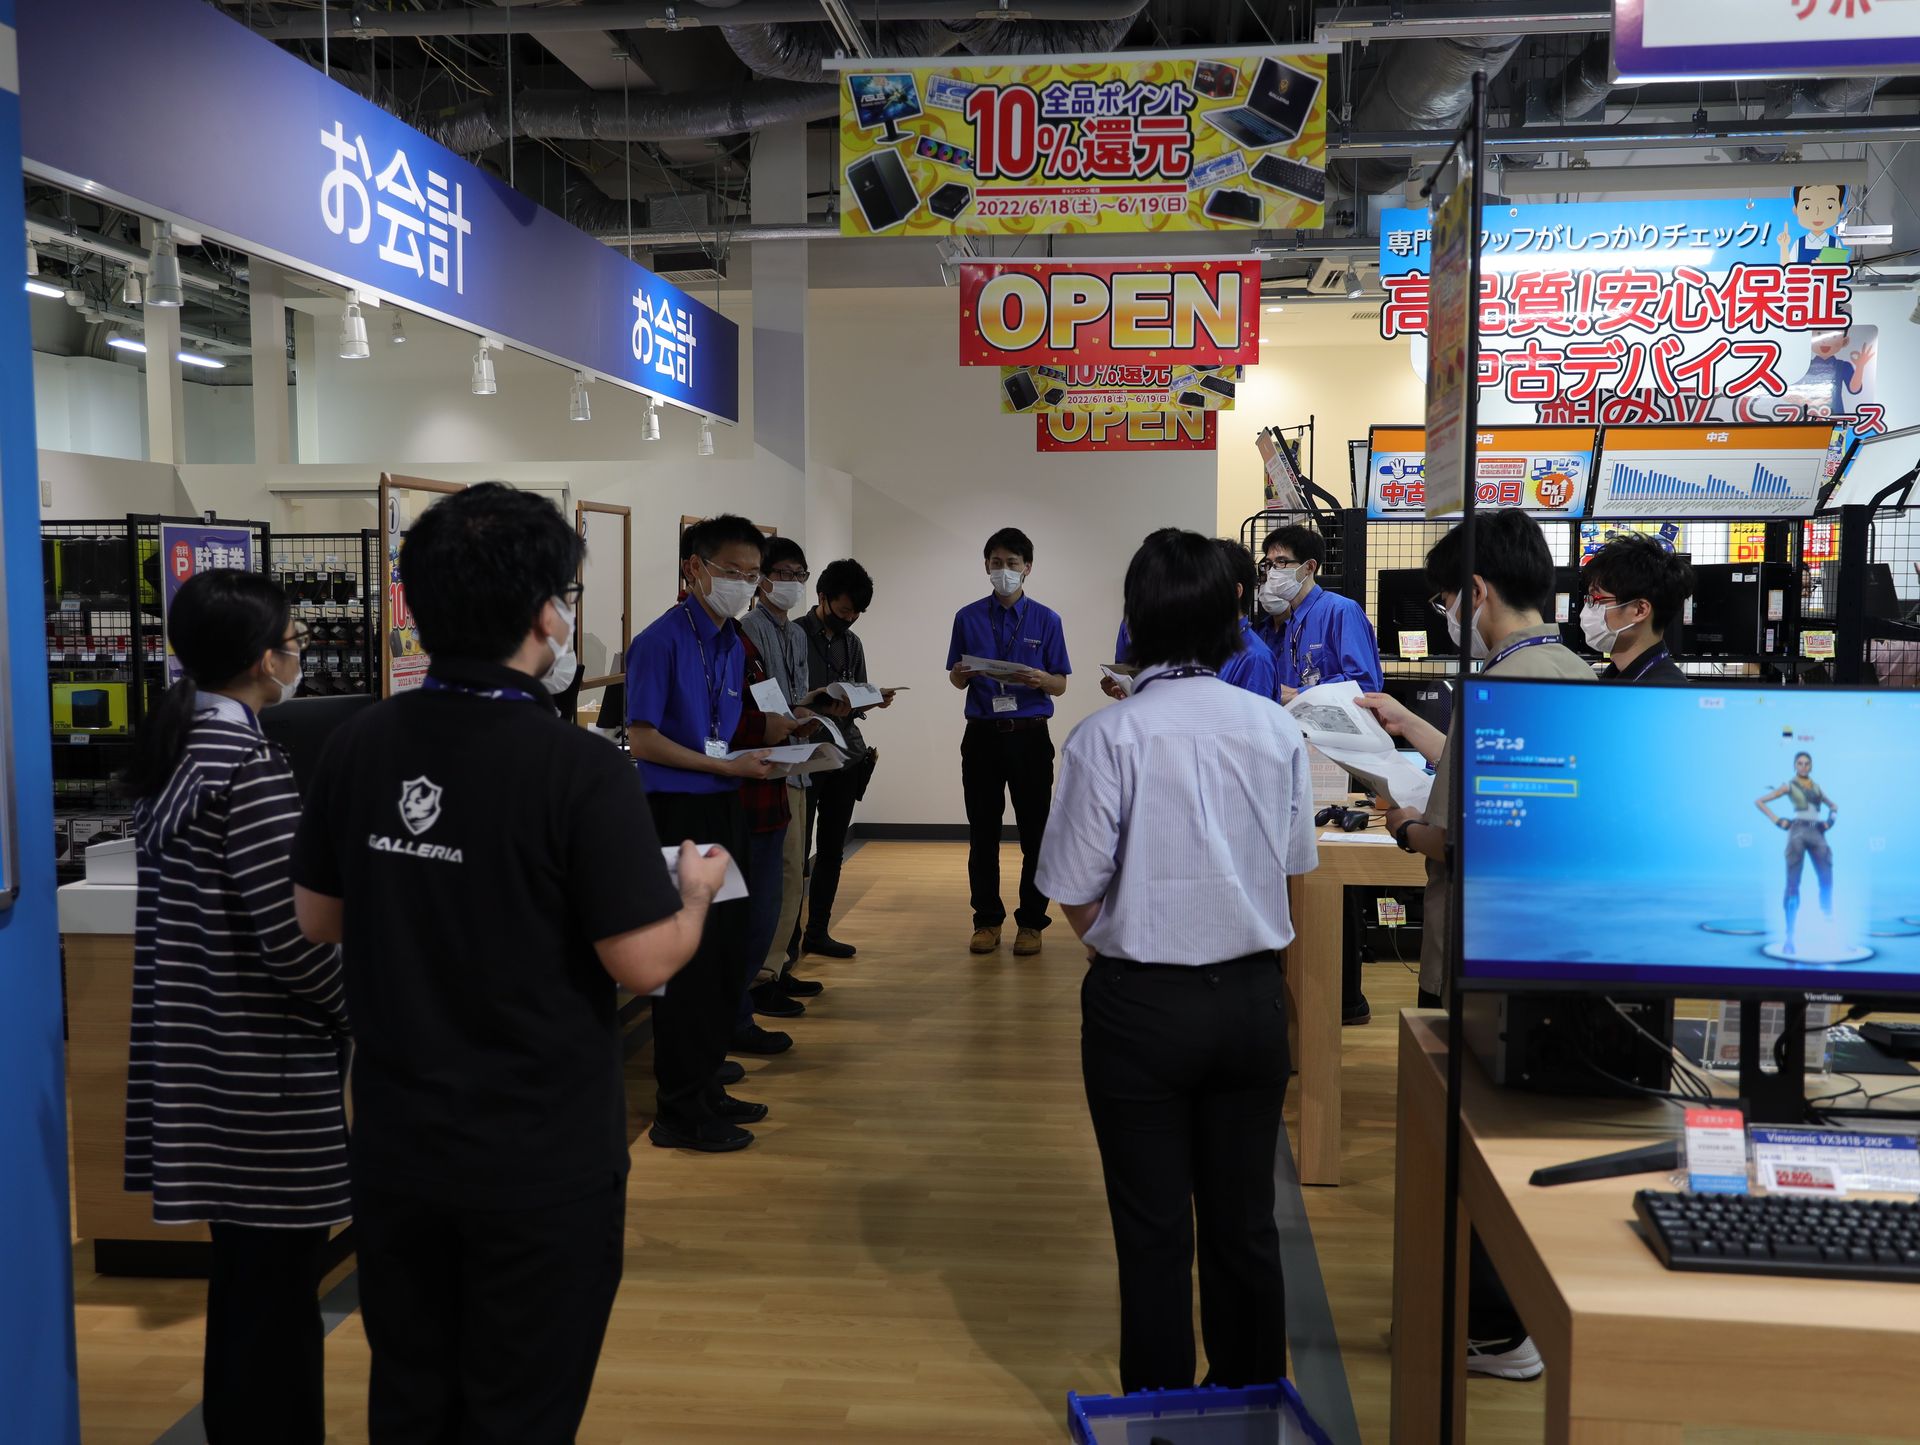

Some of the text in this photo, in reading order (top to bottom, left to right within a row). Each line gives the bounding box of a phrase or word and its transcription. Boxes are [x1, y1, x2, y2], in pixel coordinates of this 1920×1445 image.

[1042, 82, 1195, 118] 全品ポイント
[965, 84, 1192, 179] 10%還元
[319, 119, 472, 295] お会計
[1386, 220, 1771, 258] 専門ッフがしっかりチェック!
[978, 272, 1242, 350] OPEN
[630, 287, 698, 388] お会計
[1048, 410, 1206, 443] OPEN
[1706, 432, 1730, 443] 中古
[1380, 480, 1524, 506] 中古の日
[1541, 480, 1560, 495] 5%
[1549, 494, 1565, 506] UP
[176, 557, 189, 577] P
[1475, 737, 1525, 751] シーズン3
[368, 833, 463, 864] GALLERIA
[1766, 1132, 1818, 1144] Viewsonic
